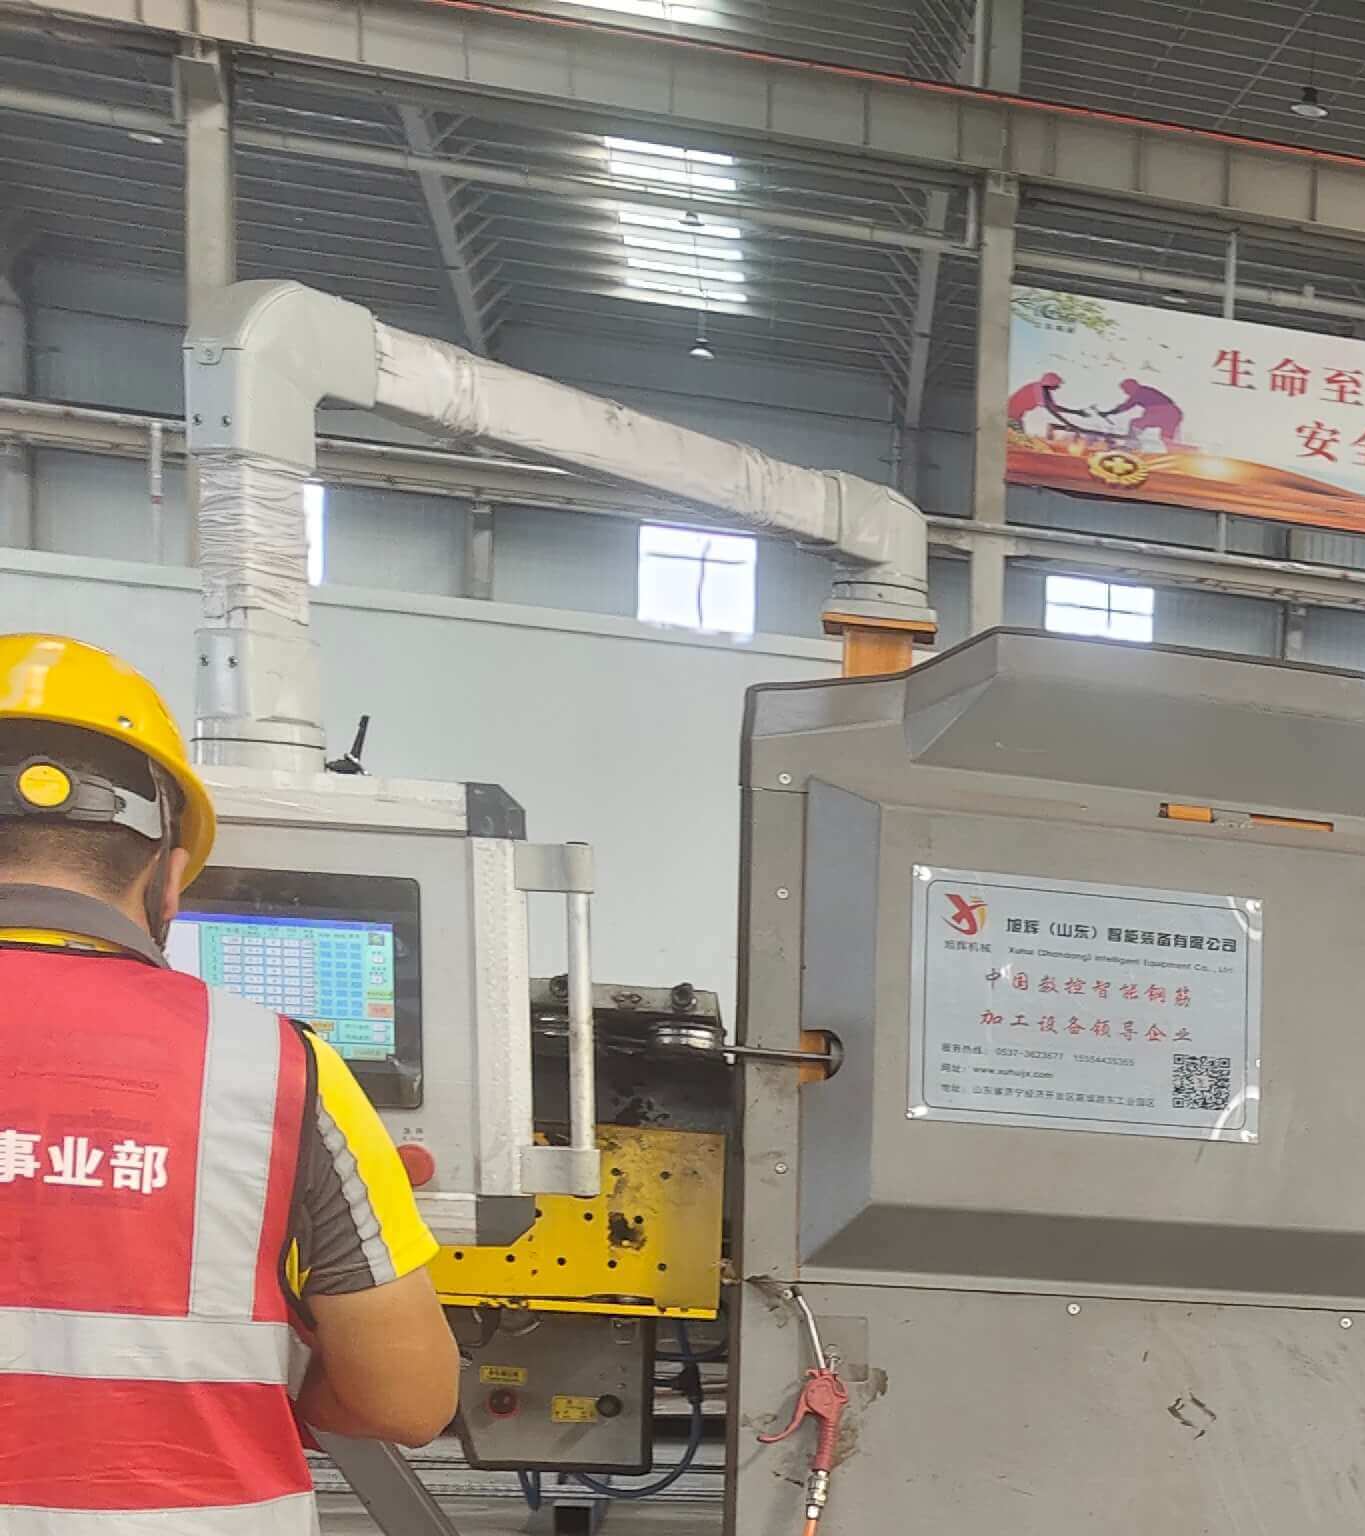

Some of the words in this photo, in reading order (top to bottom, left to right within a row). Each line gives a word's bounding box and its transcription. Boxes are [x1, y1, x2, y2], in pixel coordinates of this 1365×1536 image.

[985, 967, 1191, 1008] 中国数控智能钢筋
[979, 1009, 1193, 1043] 加工设备领导企业
[0, 1129, 169, 1194] 事业部
